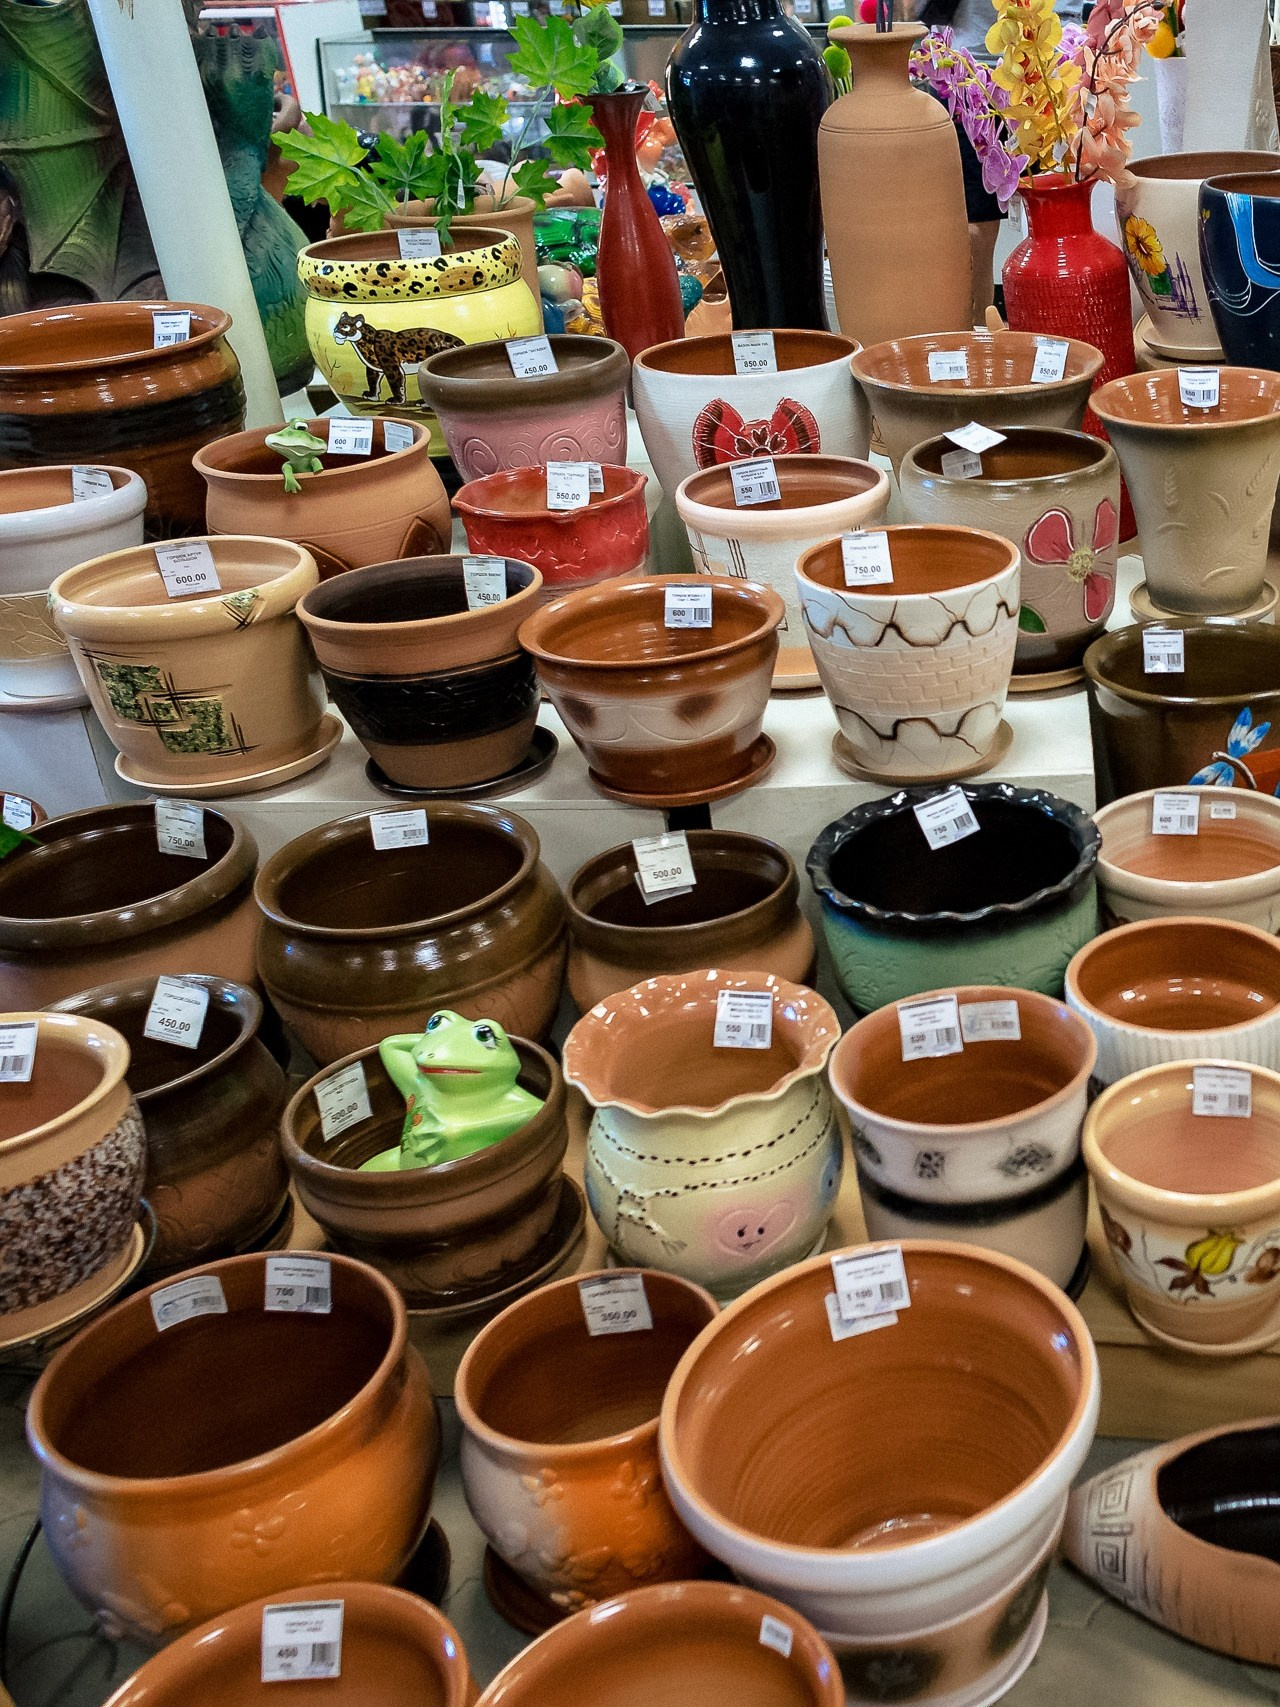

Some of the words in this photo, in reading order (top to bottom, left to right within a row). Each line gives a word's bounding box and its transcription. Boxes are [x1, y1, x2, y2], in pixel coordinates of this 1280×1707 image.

[744, 360, 768, 368] 850.00
[524, 364, 548, 374] 450.00
[1040, 368, 1058, 376] 850.00
[741, 486, 752, 494] 550
[556, 492, 580, 500] 550.00
[854, 566, 881, 574] 750.00
[176, 573, 207, 584] 600.00
[477, 593, 501, 602] 450.00
[168, 836, 194, 848] 750.00
[653, 866, 682, 879] 500.00
[158, 1017, 191, 1031] 450.00
[331, 1102, 359, 1124] 500.00
